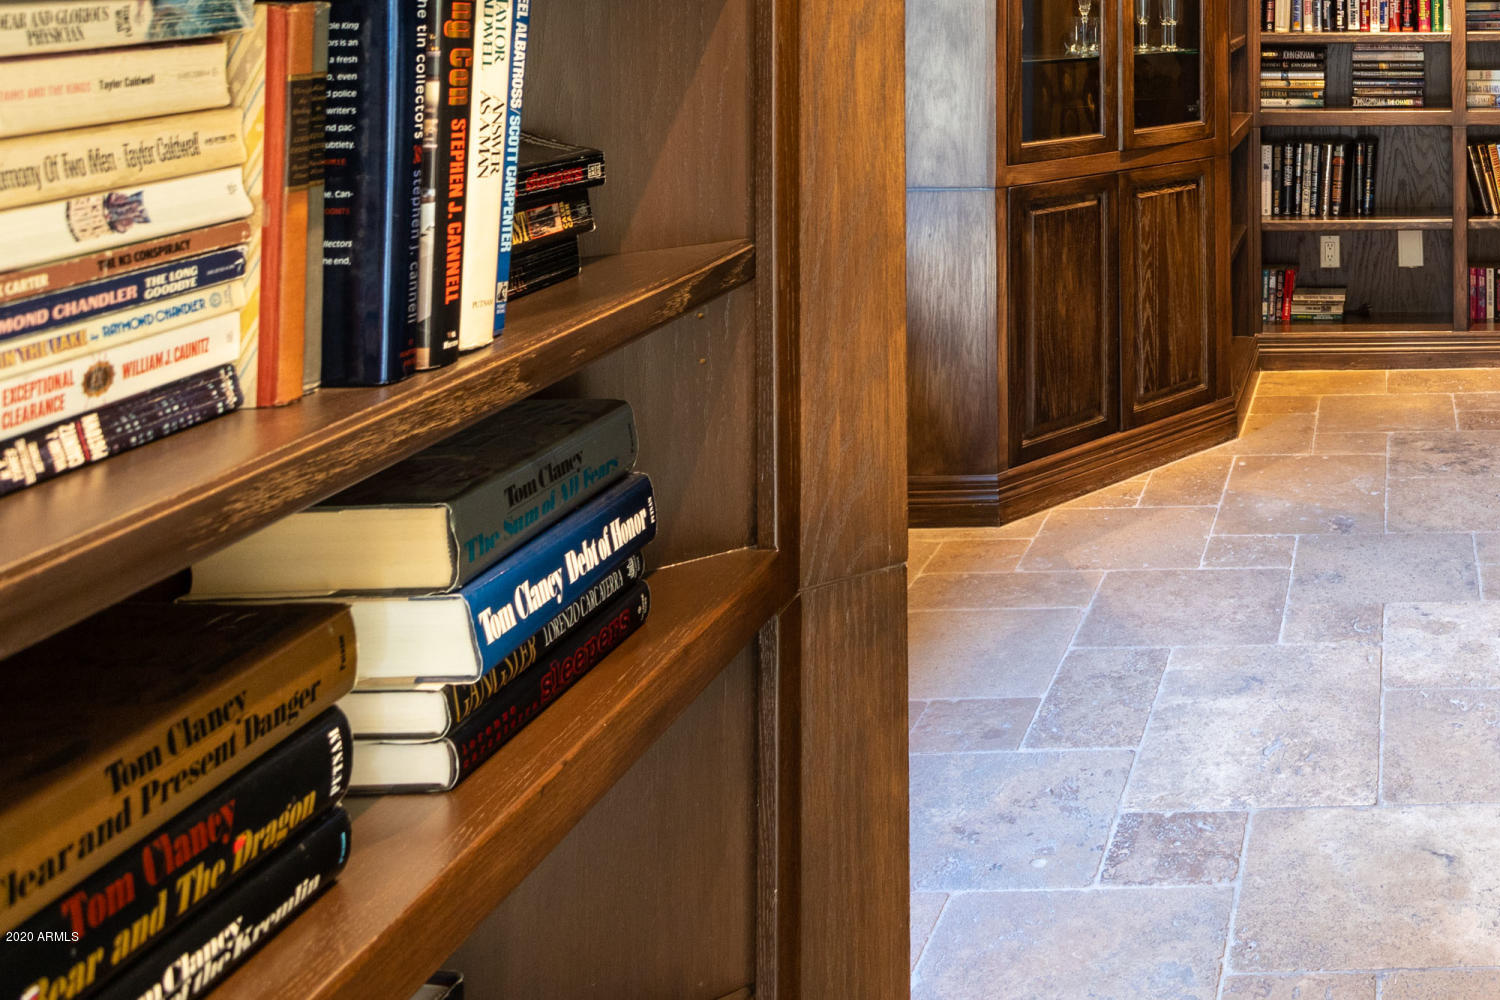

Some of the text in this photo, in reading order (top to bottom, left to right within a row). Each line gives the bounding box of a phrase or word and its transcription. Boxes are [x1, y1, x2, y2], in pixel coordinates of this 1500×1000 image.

[416, 24, 427, 48] tin
[98, 74, 156, 92] Taylor Caldwell
[413, 54, 426, 140] collectors
[448, 48, 473, 106] Con
[61, 148, 118, 178] Two Men
[448, 118, 466, 199] STEPHEN
[500, 166, 518, 253] CARPENTER
[144, 277, 199, 300] GOODBYE
[445, 221, 463, 305] CANNELL
[52, 285, 138, 321] CHANDLER
[407, 262, 419, 325] cannell
[122, 337, 211, 380] WILLIAM CAUNITZ
[1, 393, 67, 430] CLEARANCE
[2, 368, 75, 408] EXCEPTIONAL
[504, 450, 583, 508] Tom Clancy
[478, 507, 647, 645] Tom Clancy Debt Honor
[140, 680, 321, 818] Present Danger
[232, 789, 317, 875] Dragon
